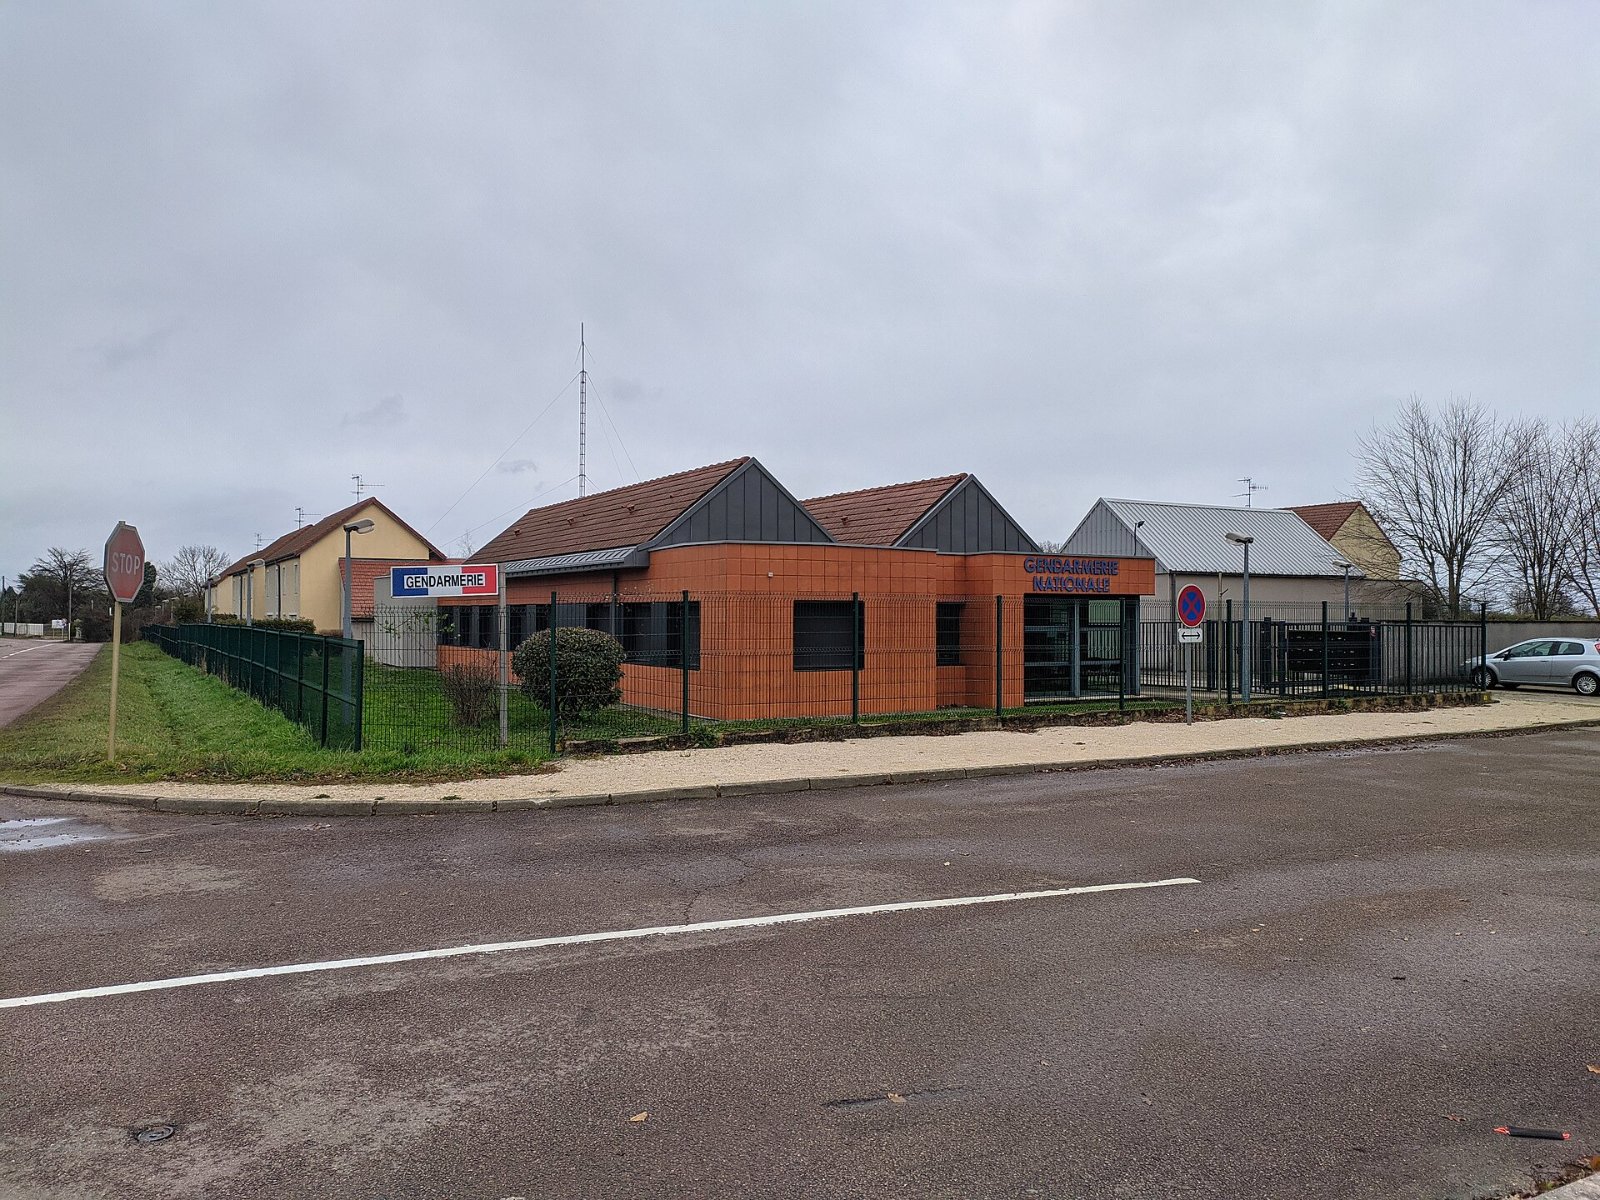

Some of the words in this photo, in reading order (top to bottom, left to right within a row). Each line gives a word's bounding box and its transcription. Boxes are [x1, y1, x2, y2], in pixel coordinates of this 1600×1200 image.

[112, 551, 141, 575] STOP
[1024, 556, 1119, 575] GENDARMERIE
[406, 573, 484, 588] GENDARMERIE
[1032, 575, 1110, 592] NATIONALE
